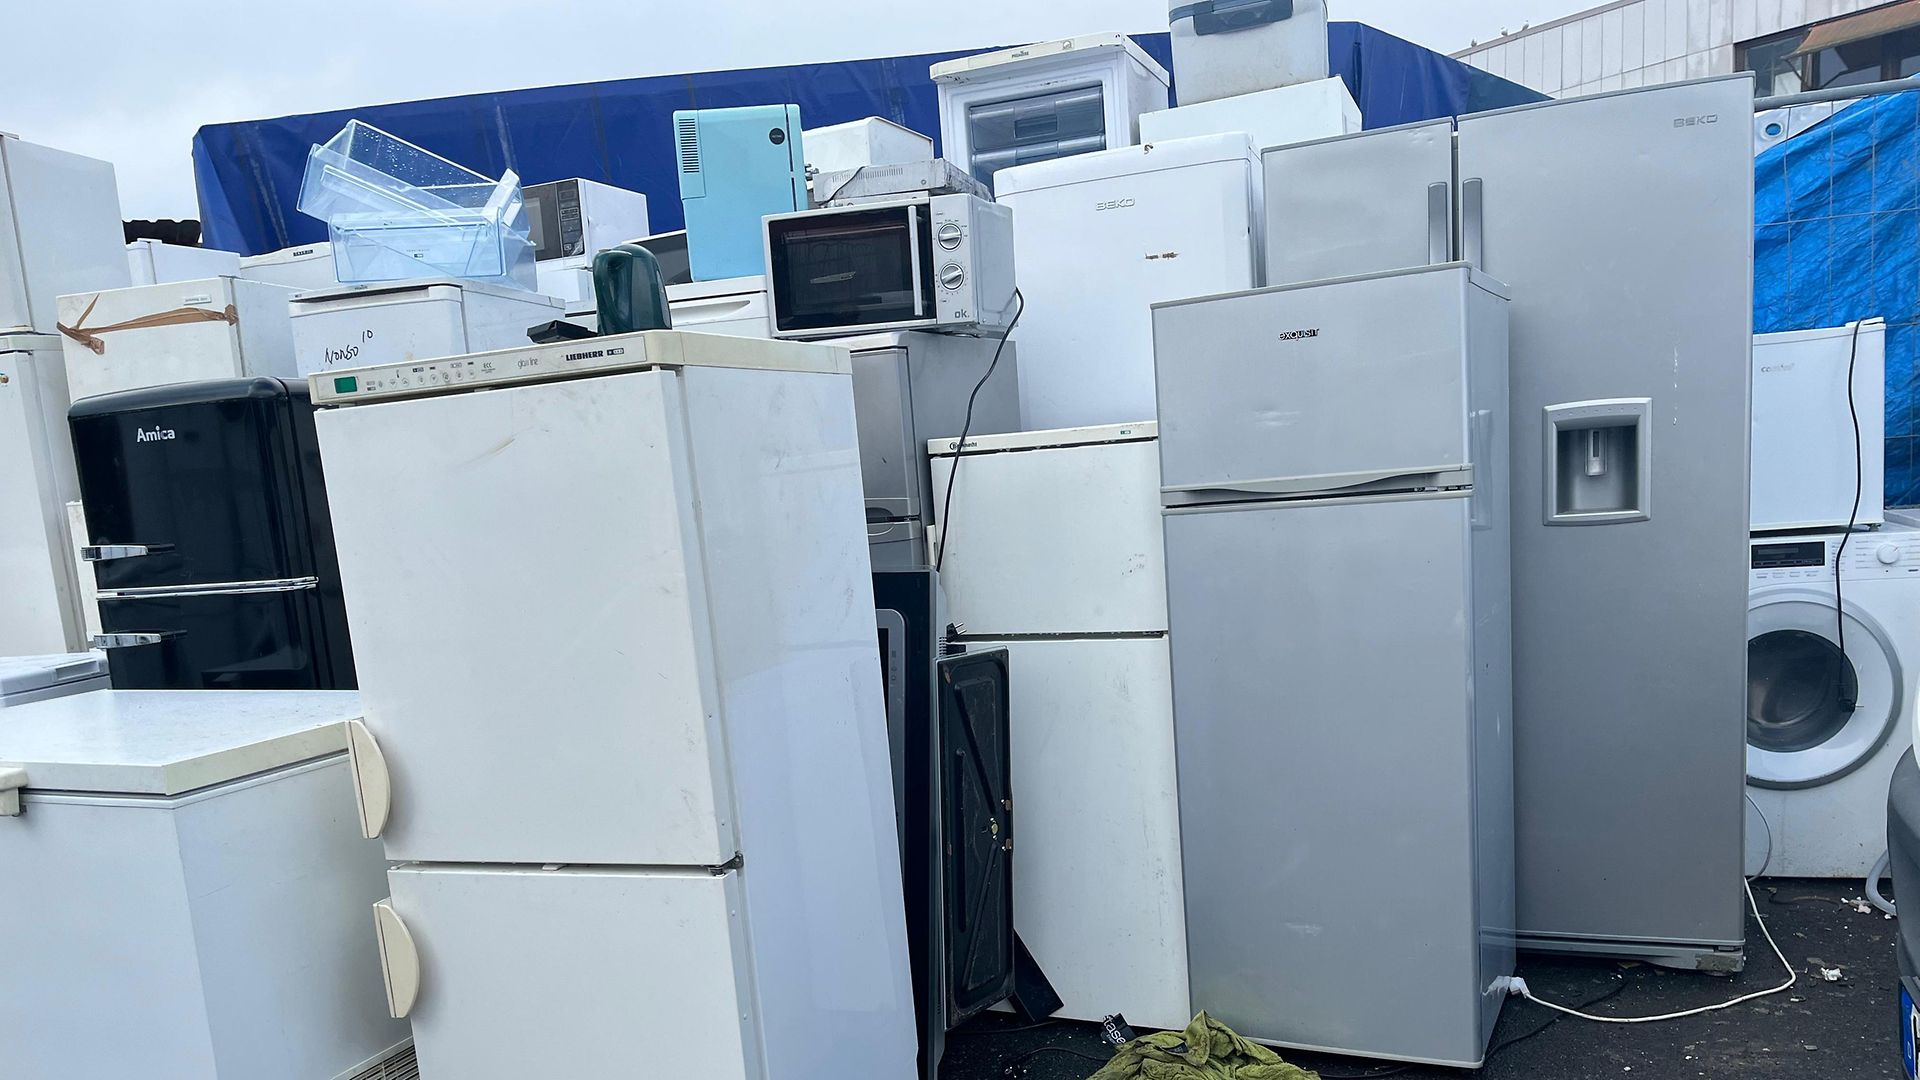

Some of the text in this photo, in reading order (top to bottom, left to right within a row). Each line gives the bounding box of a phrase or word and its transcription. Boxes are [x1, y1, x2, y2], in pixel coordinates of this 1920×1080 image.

[1673, 114, 1718, 128] BEKO
[1095, 198, 1136, 211] BEKO
[954, 309, 970, 319] ok.
[565, 350, 604, 361] LIEBHERR
[136, 425, 176, 443] Amica
